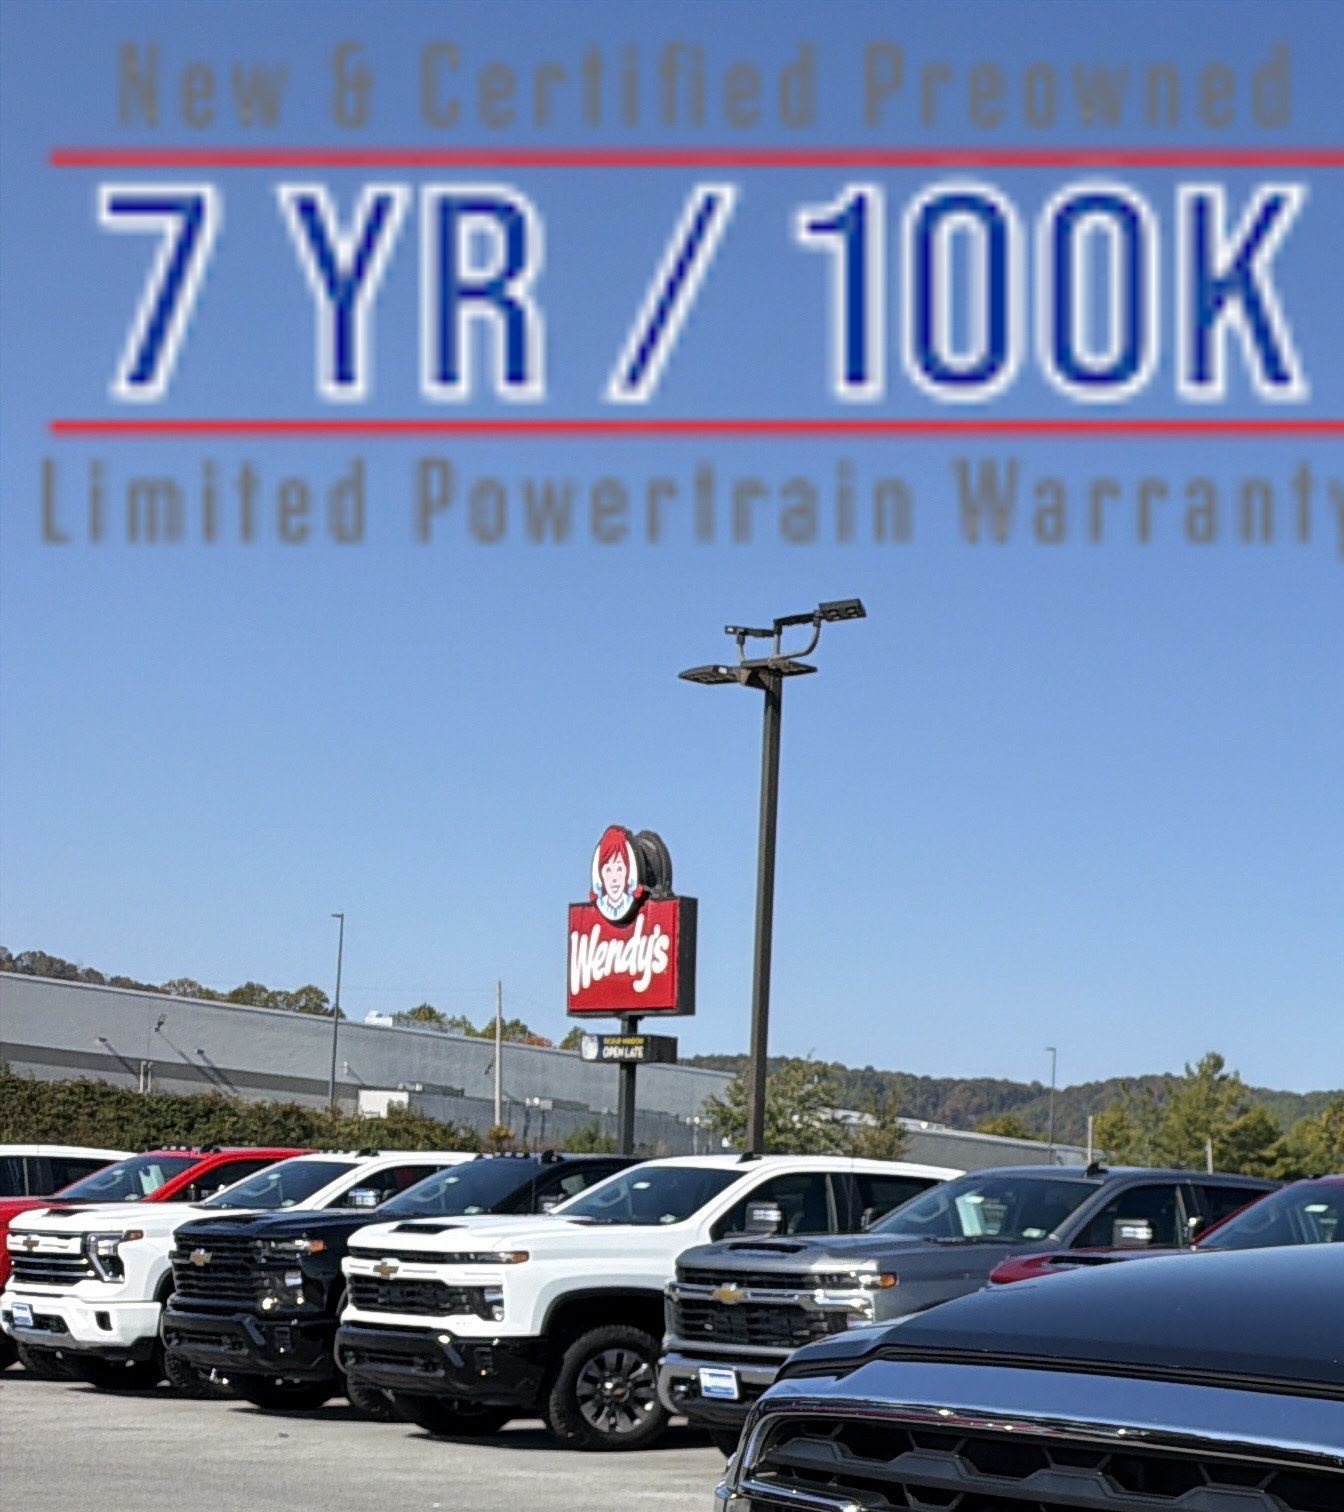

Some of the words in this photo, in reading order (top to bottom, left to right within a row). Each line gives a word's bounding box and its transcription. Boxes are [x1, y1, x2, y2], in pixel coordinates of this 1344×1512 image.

[570, 913, 670, 996] Wendy's
[603, 1046, 624, 1059] OPEN
[625, 1046, 644, 1059] LATE
